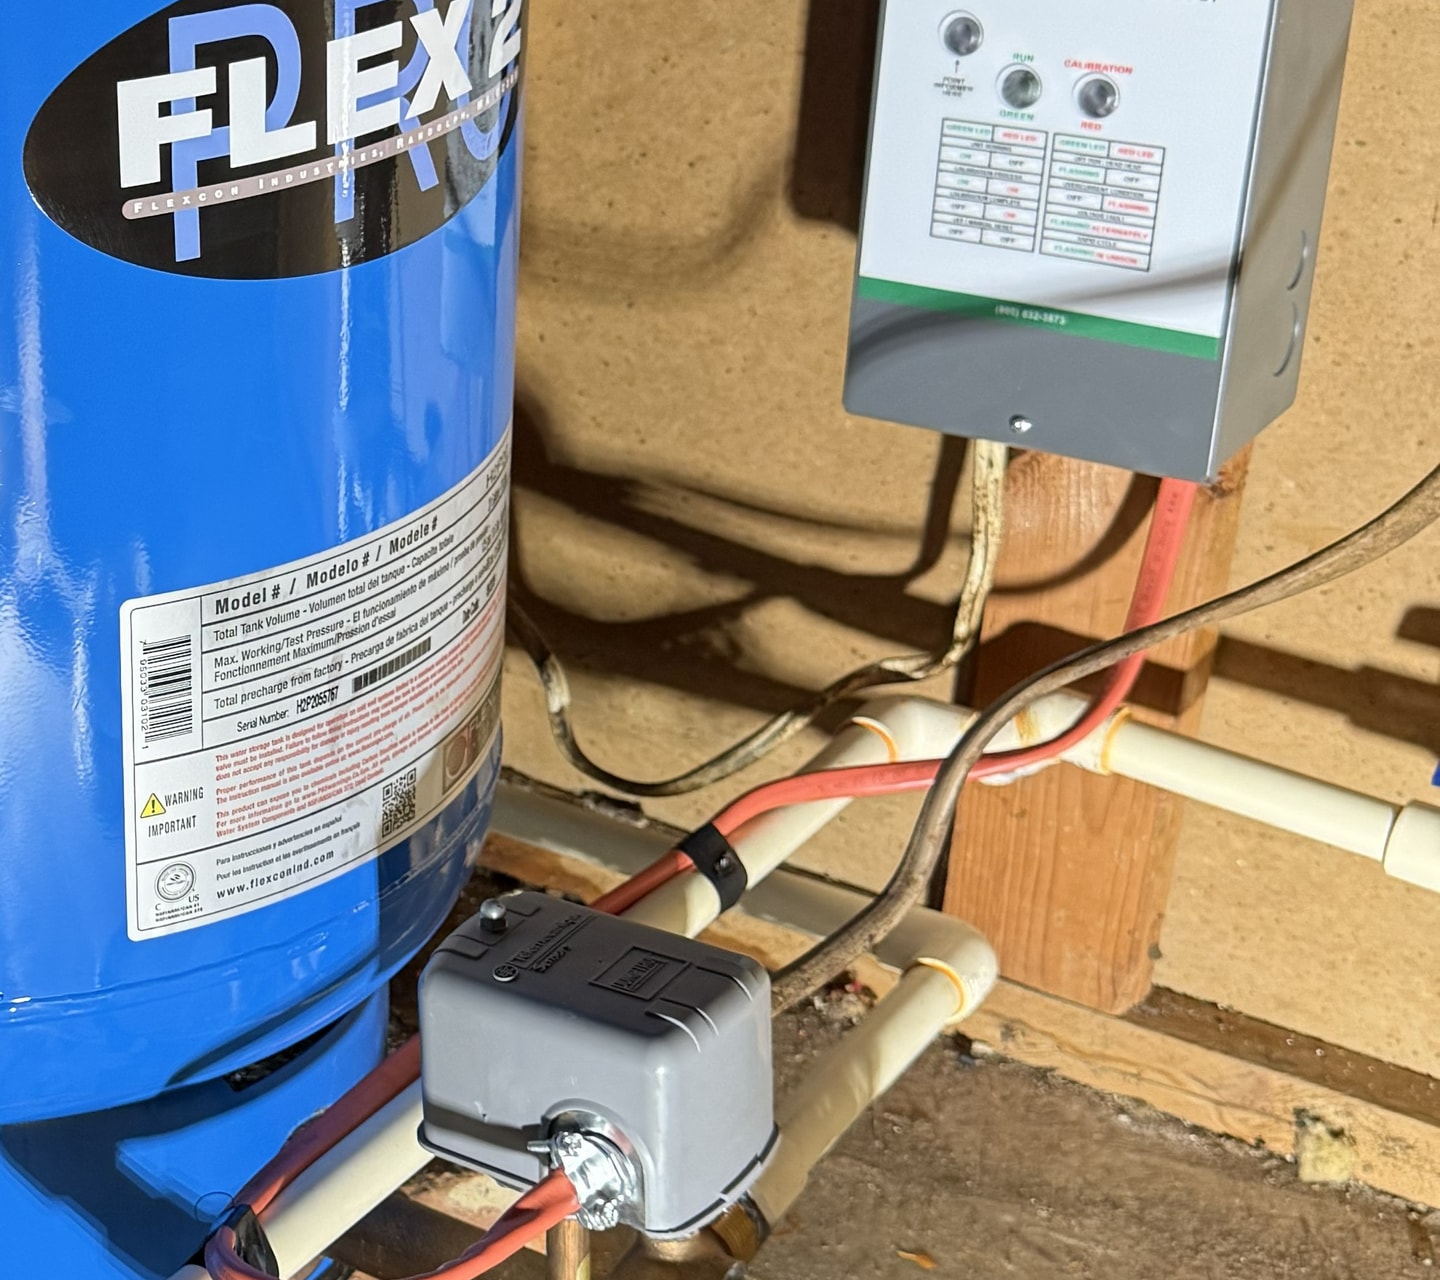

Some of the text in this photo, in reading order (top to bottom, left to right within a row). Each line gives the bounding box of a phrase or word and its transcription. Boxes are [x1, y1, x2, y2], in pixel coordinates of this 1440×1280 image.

[1013, 52, 1035, 62] RUN
[1063, 58, 1134, 75] CALIBRATION
[998, 109, 1035, 121] GREEN
[1080, 121, 1103, 131] RED
[133, 185, 239, 214] FLEXCON
[215, 515, 438, 615] Model # / Modelo # / Modele #
[213, 625, 238, 642] Total
[240, 619, 264, 635] Tank
[265, 609, 301, 627] Volume
[308, 593, 346, 614] Volumen
[347, 582, 366, 599] total
[367, 576, 379, 590] del
[381, 565, 405, 584] tanque
[214, 654, 239, 669] Max.
[241, 632, 305, 661] Working/Test
[306, 618, 345, 641] Pressure
[352, 610, 360, 624] El
[362, 583, 417, 619] funcionamiento
[418, 576, 426, 590] de
[214, 607, 397, 682] Fonctionnement Maximum/Pression d'essai
[214, 694, 238, 710] Total
[240, 678, 289, 705] precharge
[291, 671, 312, 687] from
[313, 660, 343, 679] factory
[350, 640, 385, 664] Precarga
[385, 635, 395, 647] de
[395, 622, 419, 642] fabrica
[419, 613, 429, 629] del
[429, 602, 449, 624] tanque
[236, 685, 339, 732] Serial Number: H2P2055767
[215, 753, 229, 762] This
[230, 748, 247, 758] water
[249, 742, 270, 753] storage
[271, 737, 284, 746] tank
[291, 725, 316, 740] designed
[215, 762, 232, 772] valve
[233, 757, 249, 767] must
[285, 739, 304, 751] Failure
[215, 772, 231, 782] does
[231, 768, 242, 777] not
[242, 761, 263, 774] accept
[263, 759, 274, 768] any
[216, 785, 237, 796] Proper
[239, 772, 277, 790] performance
[278, 768, 285, 777] of
[286, 765, 298, 774] this
[164, 786, 205, 807] WARNING
[216, 797, 227, 805] The
[228, 787, 260, 801] instruction
[260, 778, 281, 792] manual
[216, 811, 229, 819] This
[231, 802, 255, 816] product
[256, 799, 268, 808] can
[291, 788, 302, 797] you
[148, 815, 197, 838] IMPORTANT
[216, 820, 227, 829] For
[229, 816, 246, 825] more
[247, 803, 283, 819] information
[284, 800, 293, 808] go
[216, 828, 236, 838] Water
[237, 820, 261, 832] System
[216, 856, 231, 866] Para
[216, 871, 231, 881] Pour
[232, 868, 242, 877] les
[275, 854, 282, 863] et
[282, 851, 291, 860] les
[188, 893, 200, 903] US
